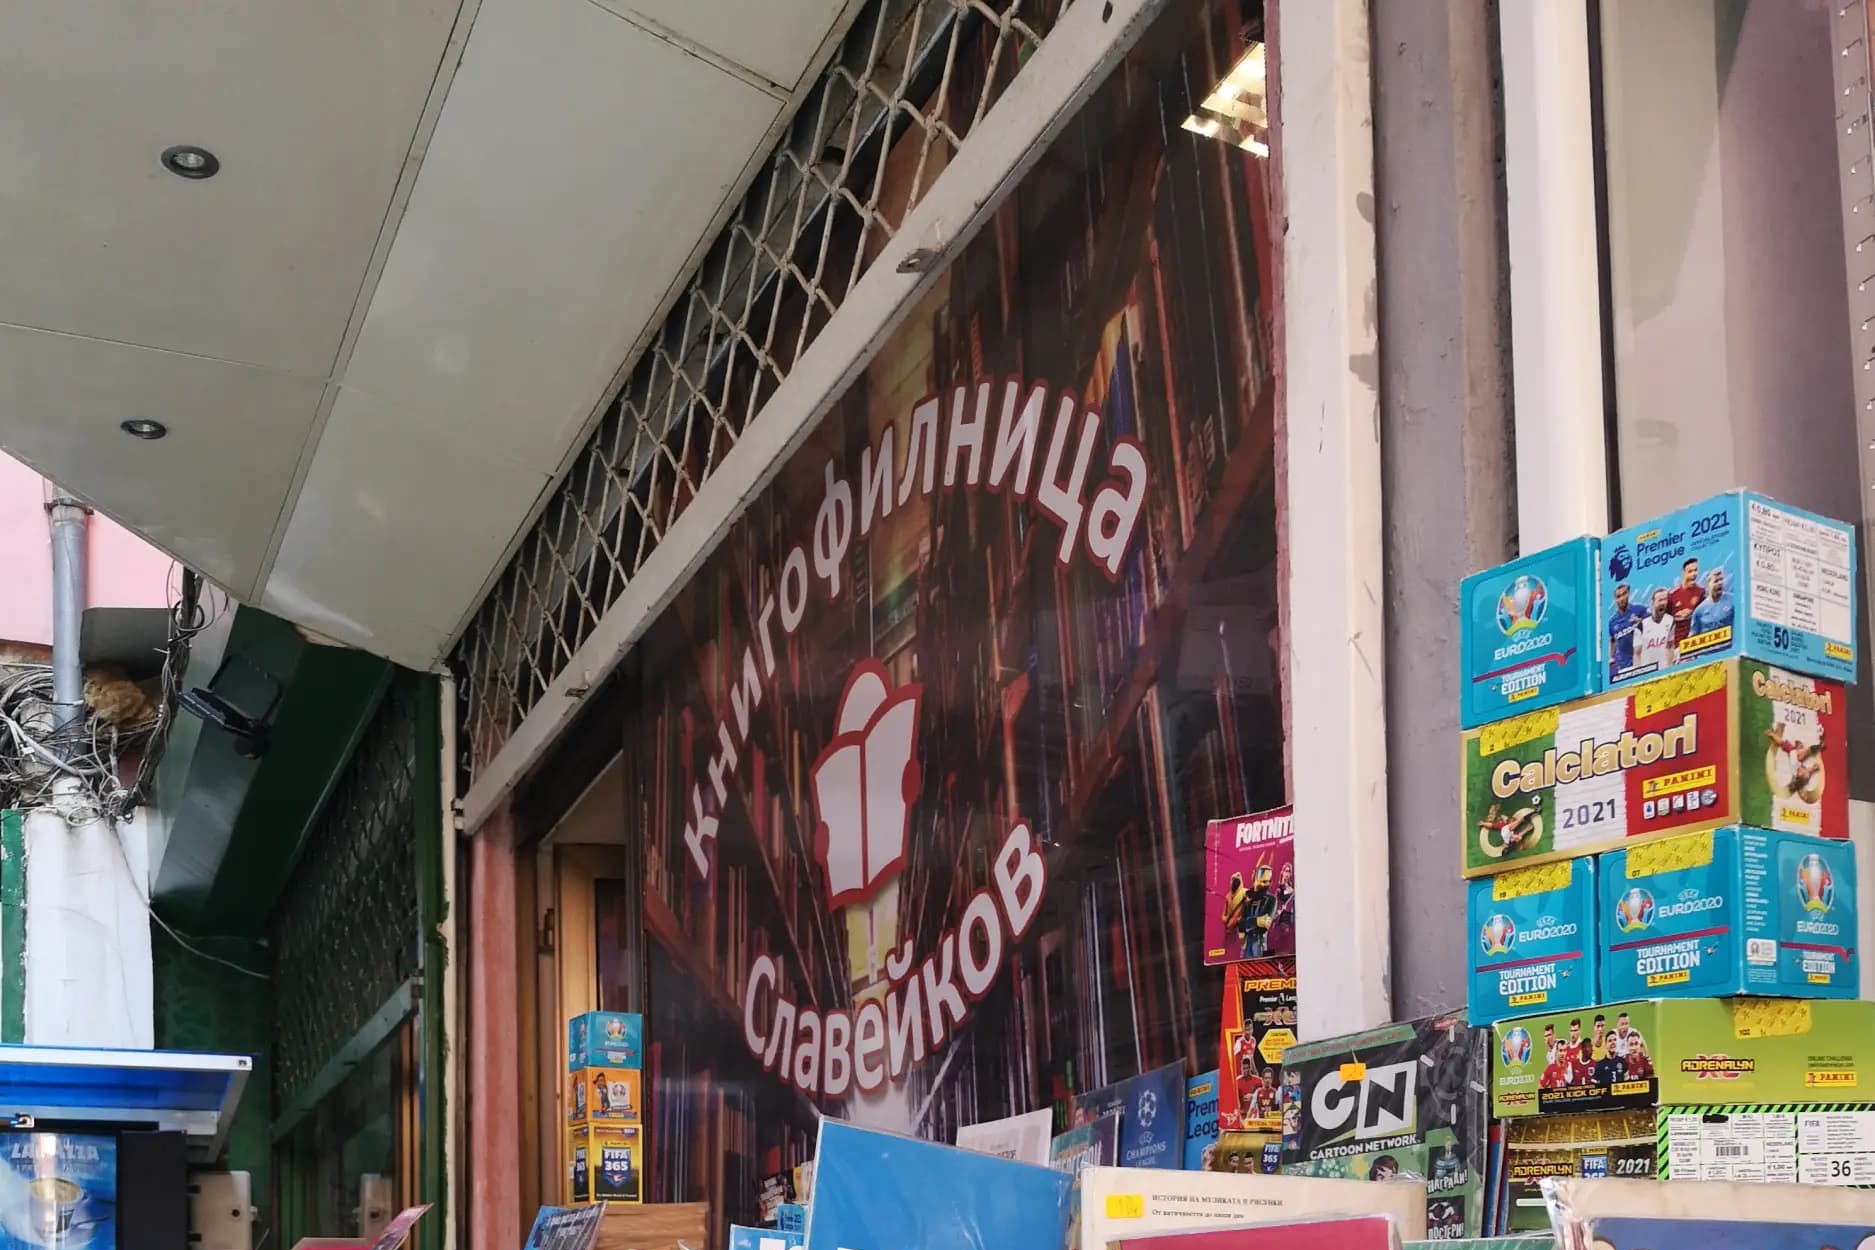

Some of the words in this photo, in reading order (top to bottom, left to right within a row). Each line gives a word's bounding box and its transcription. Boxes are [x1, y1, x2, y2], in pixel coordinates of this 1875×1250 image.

[1691, 511, 1730, 537] 2021
[1637, 532, 1685, 556] Premier
[1637, 545, 1685, 570] League
[1683, 630, 1728, 649] PANINI
[1773, 627, 1789, 649] 50
[1502, 672, 1546, 695] EDITION
[1784, 708, 1806, 725] 2021
[1663, 770, 1712, 787] PANINI
[1563, 799, 1616, 829] 2021
[1659, 896, 1723, 918] EURO2020
[1519, 923, 1577, 942] EURO2020
[746, 824, 1044, 1094] Славейков
[1636, 940, 1700, 959] TOURNAMENT
[1499, 964, 1555, 980] TOURNAMENT
[1636, 952, 1700, 975] EDITION
[1499, 975, 1556, 995] EDITION
[1681, 1060, 1754, 1071] ADRENALYN
[1820, 1073, 1854, 1081] PANINI
[1311, 1060, 1418, 1140] CN
[1541, 1091, 1564, 1100] 2021
[1566, 1090, 1587, 1098] KICK
[1589, 1087, 1607, 1096] OFF
[604, 1150, 628, 1160] FIFA
[1126, 1141, 1166, 1160] CHAMPIONS
[1310, 1143, 1363, 1160] CARTOON
[1365, 1135, 1417, 1153] NETWORK
[604, 1161, 629, 1171] 365
[1263, 1154, 1278, 1163] 365
[1584, 1159, 1605, 1169] FIFA
[1616, 1158, 1651, 1174] 2021
[1514, 1164, 1573, 1176] ADRENALYN
[1831, 1160, 1851, 1177] 36
